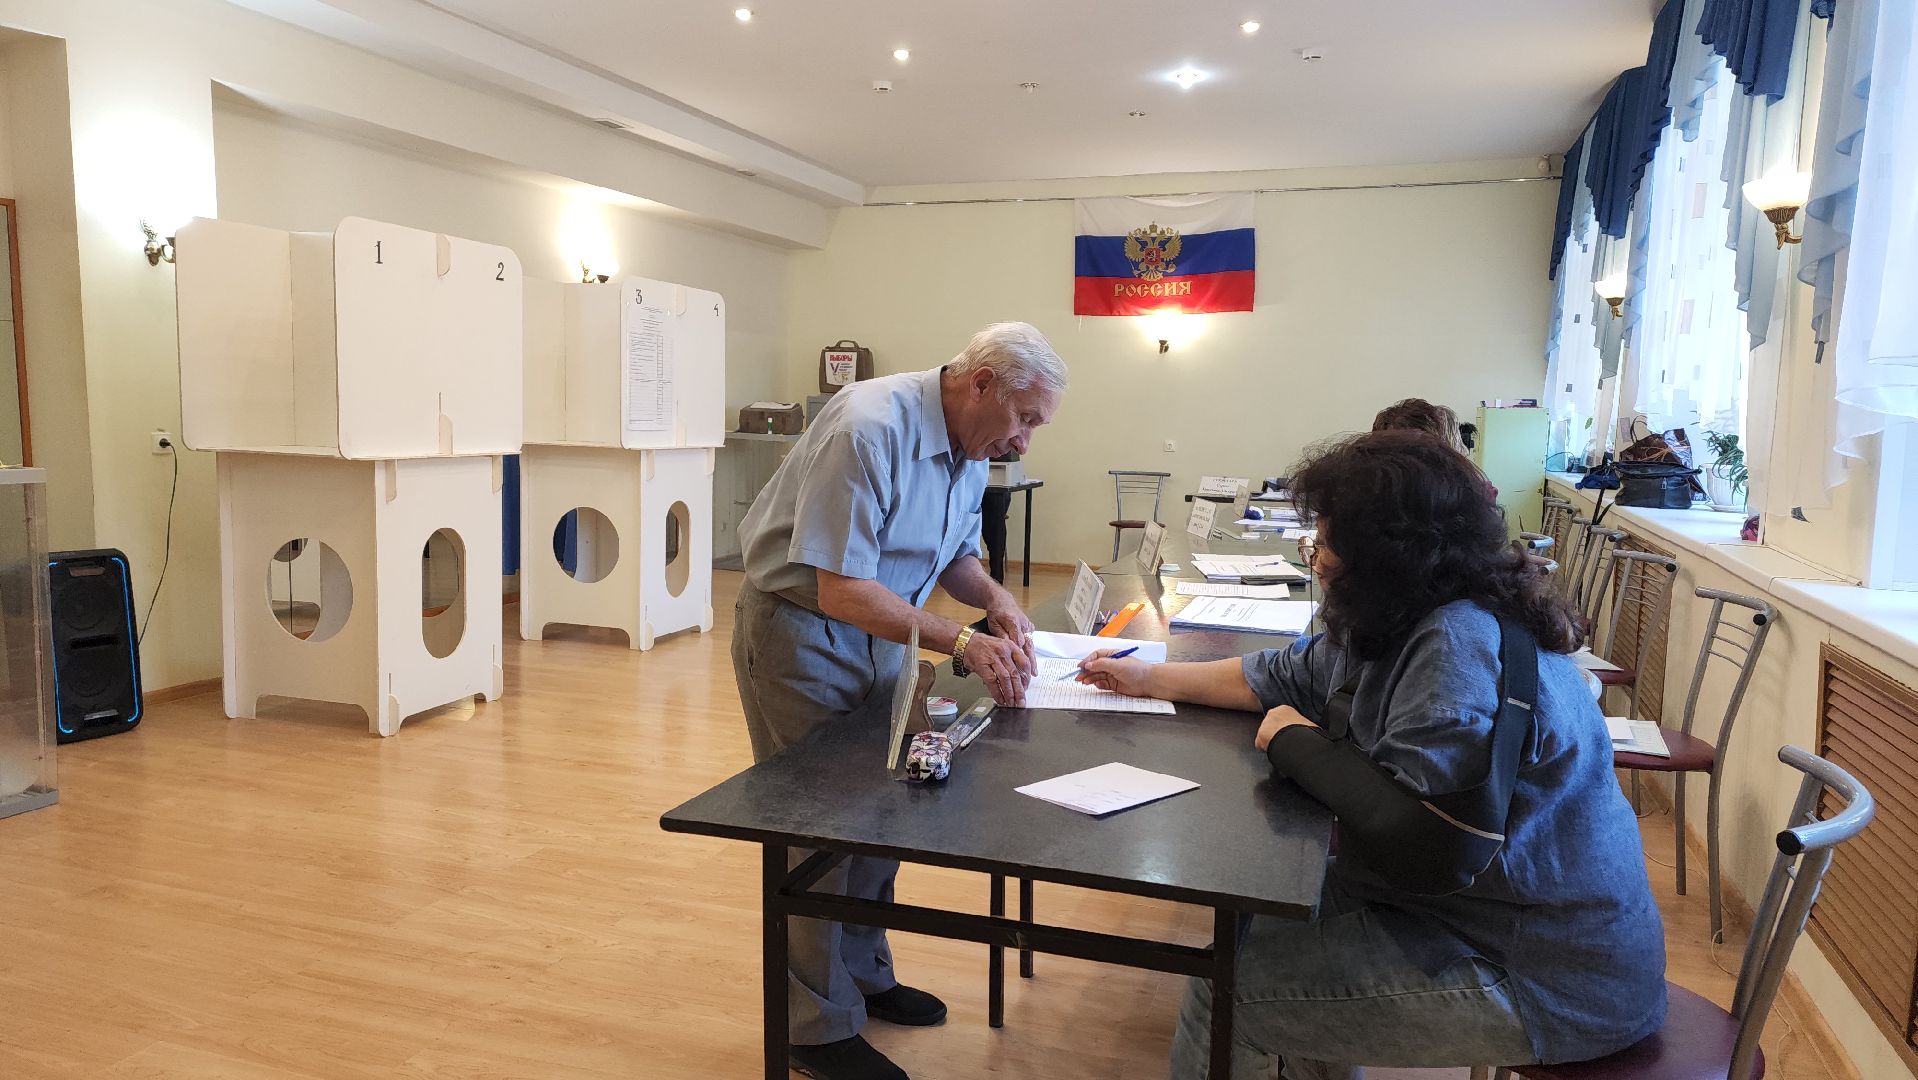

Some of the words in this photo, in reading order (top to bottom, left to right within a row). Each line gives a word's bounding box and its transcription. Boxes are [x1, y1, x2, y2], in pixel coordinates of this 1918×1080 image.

[374, 240, 383, 264] 1
[495, 261, 505, 281] 2
[635, 288, 643, 304] 3
[1114, 281, 1192, 297] РОССИЯ
[713, 303, 720, 317] 4
